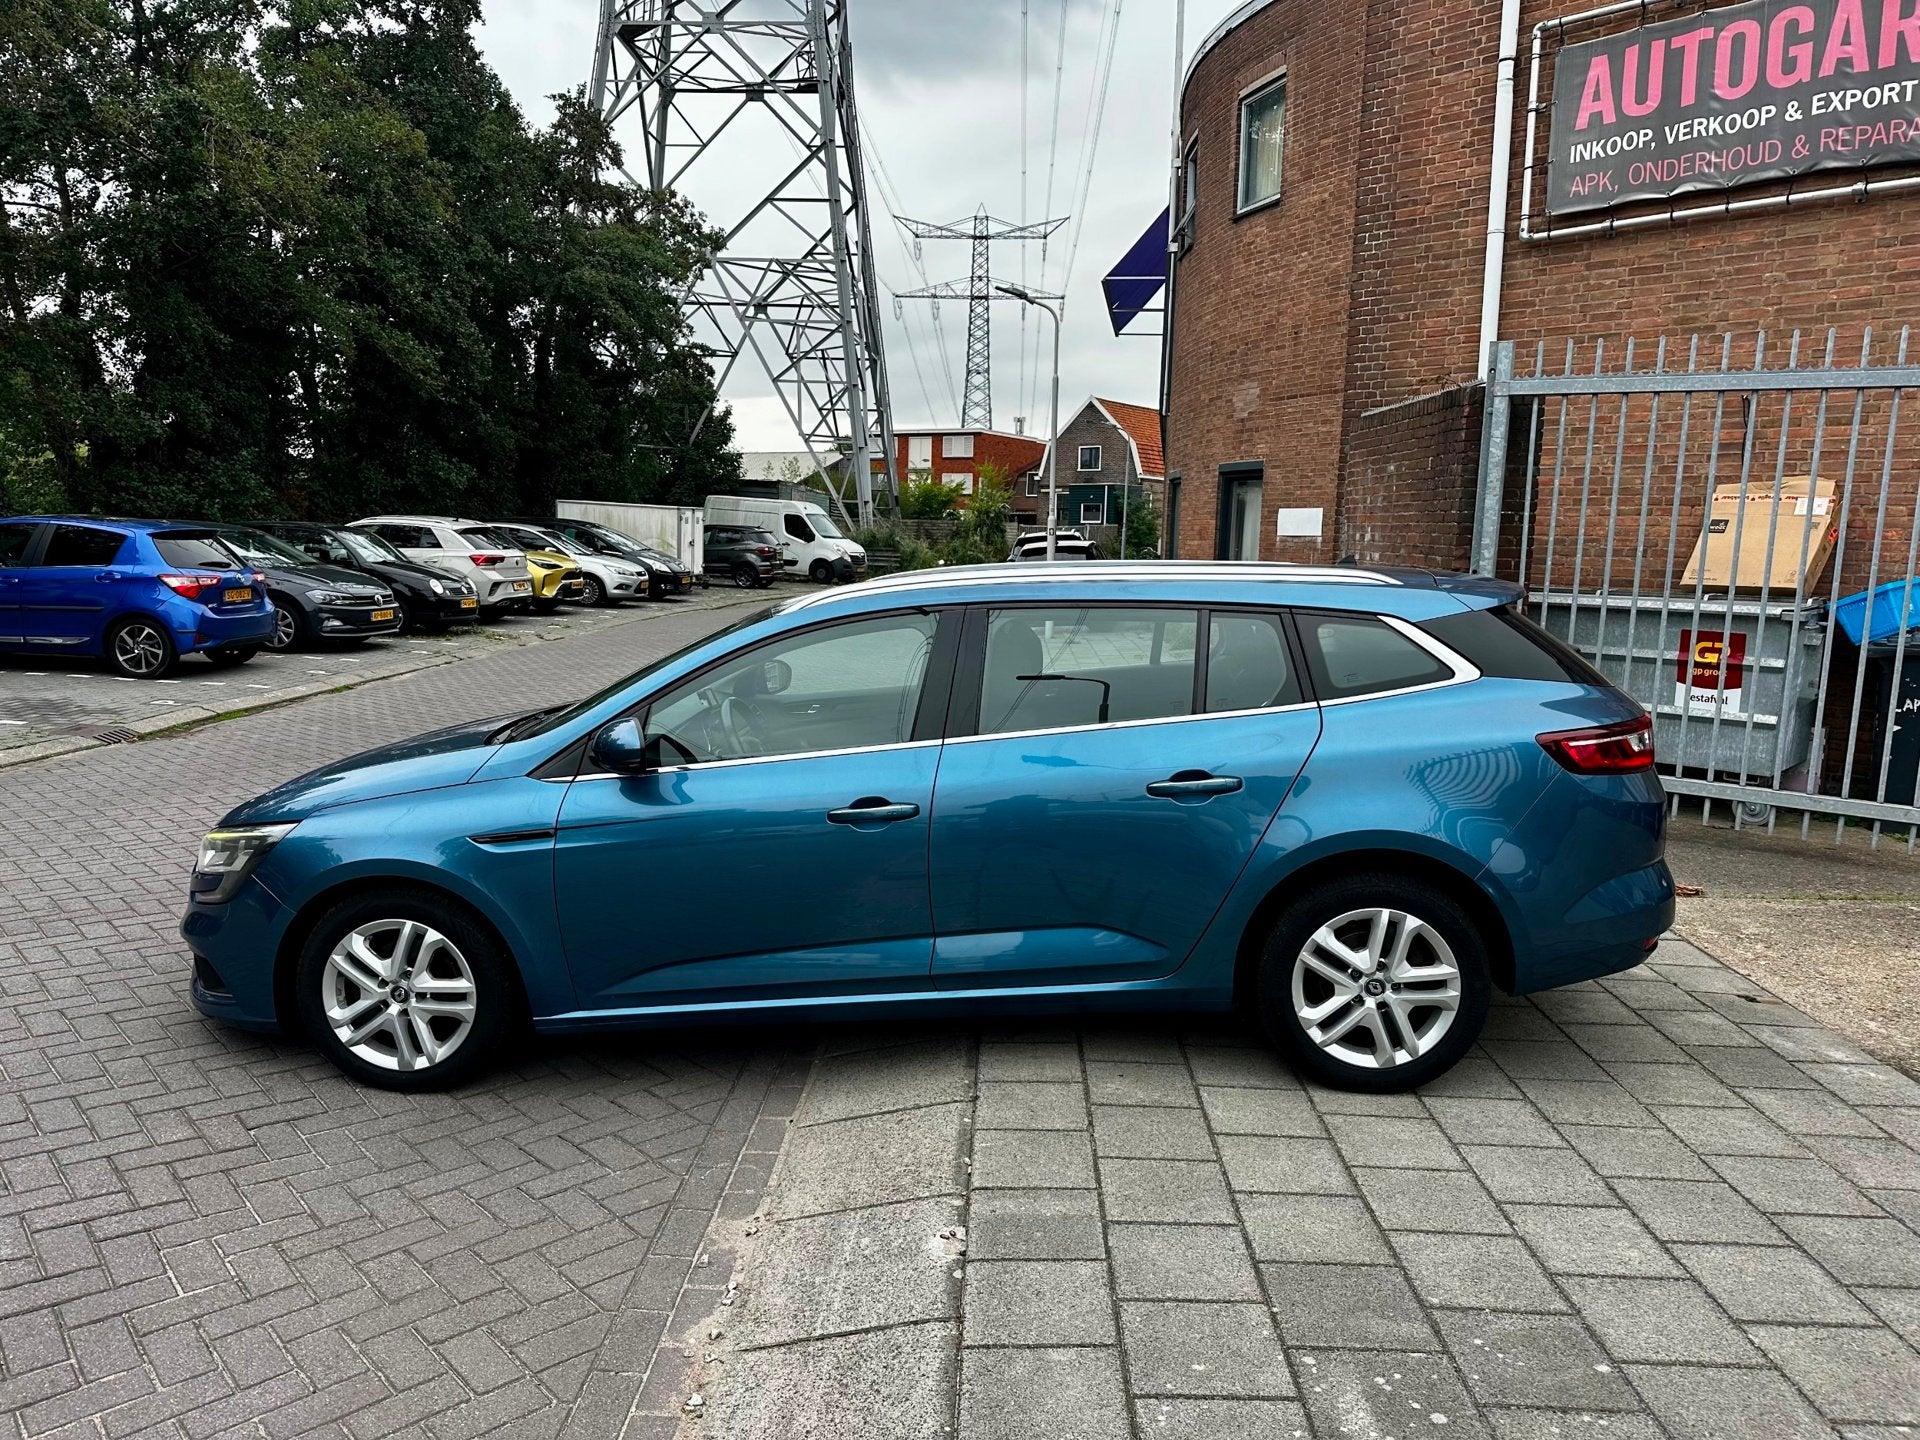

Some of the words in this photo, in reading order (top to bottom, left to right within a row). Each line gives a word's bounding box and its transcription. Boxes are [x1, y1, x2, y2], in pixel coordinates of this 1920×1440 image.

[1569, 129, 1656, 164] INKOOP,
[1664, 105, 1777, 145] VERKOOP
[1784, 100, 1804, 123] &
[1811, 80, 1919, 116] EXPORT
[1569, 174, 1619, 198] APK,
[1628, 139, 1783, 186] ONDERHOUD
[1791, 134, 1811, 160] &
